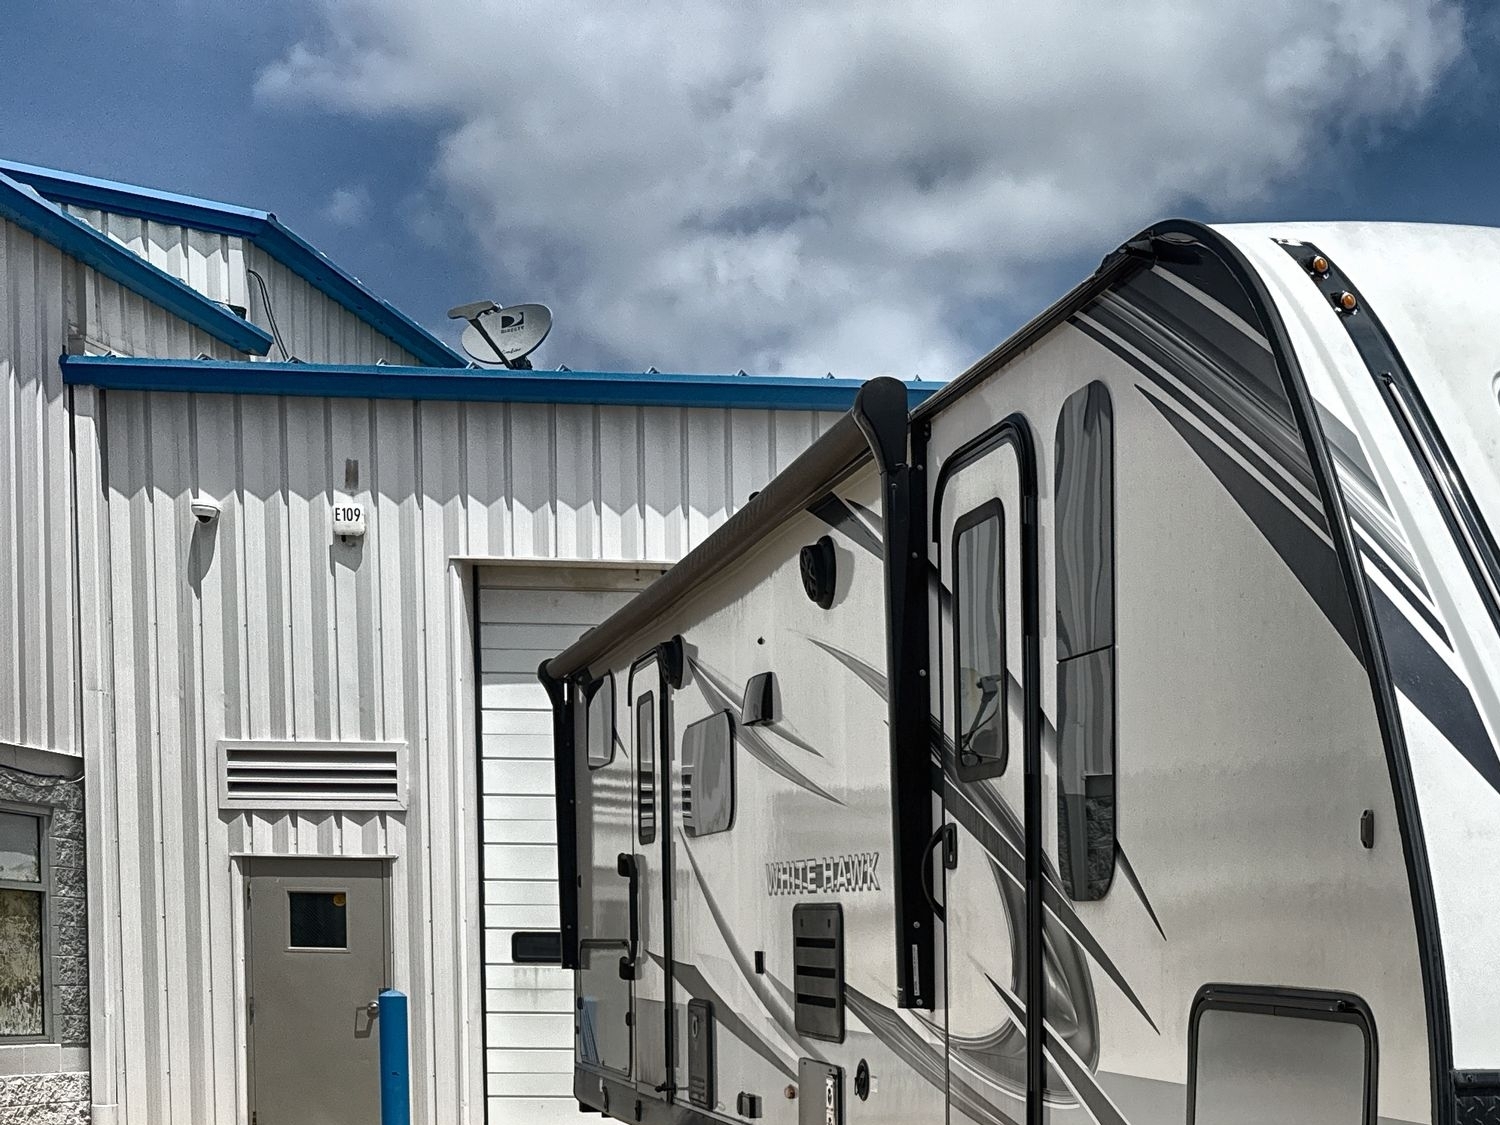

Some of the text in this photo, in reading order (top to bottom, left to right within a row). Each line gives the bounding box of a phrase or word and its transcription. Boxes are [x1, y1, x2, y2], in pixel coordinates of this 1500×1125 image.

[335, 507, 361, 522] E109
[765, 852, 881, 896] WHITE HAWK
